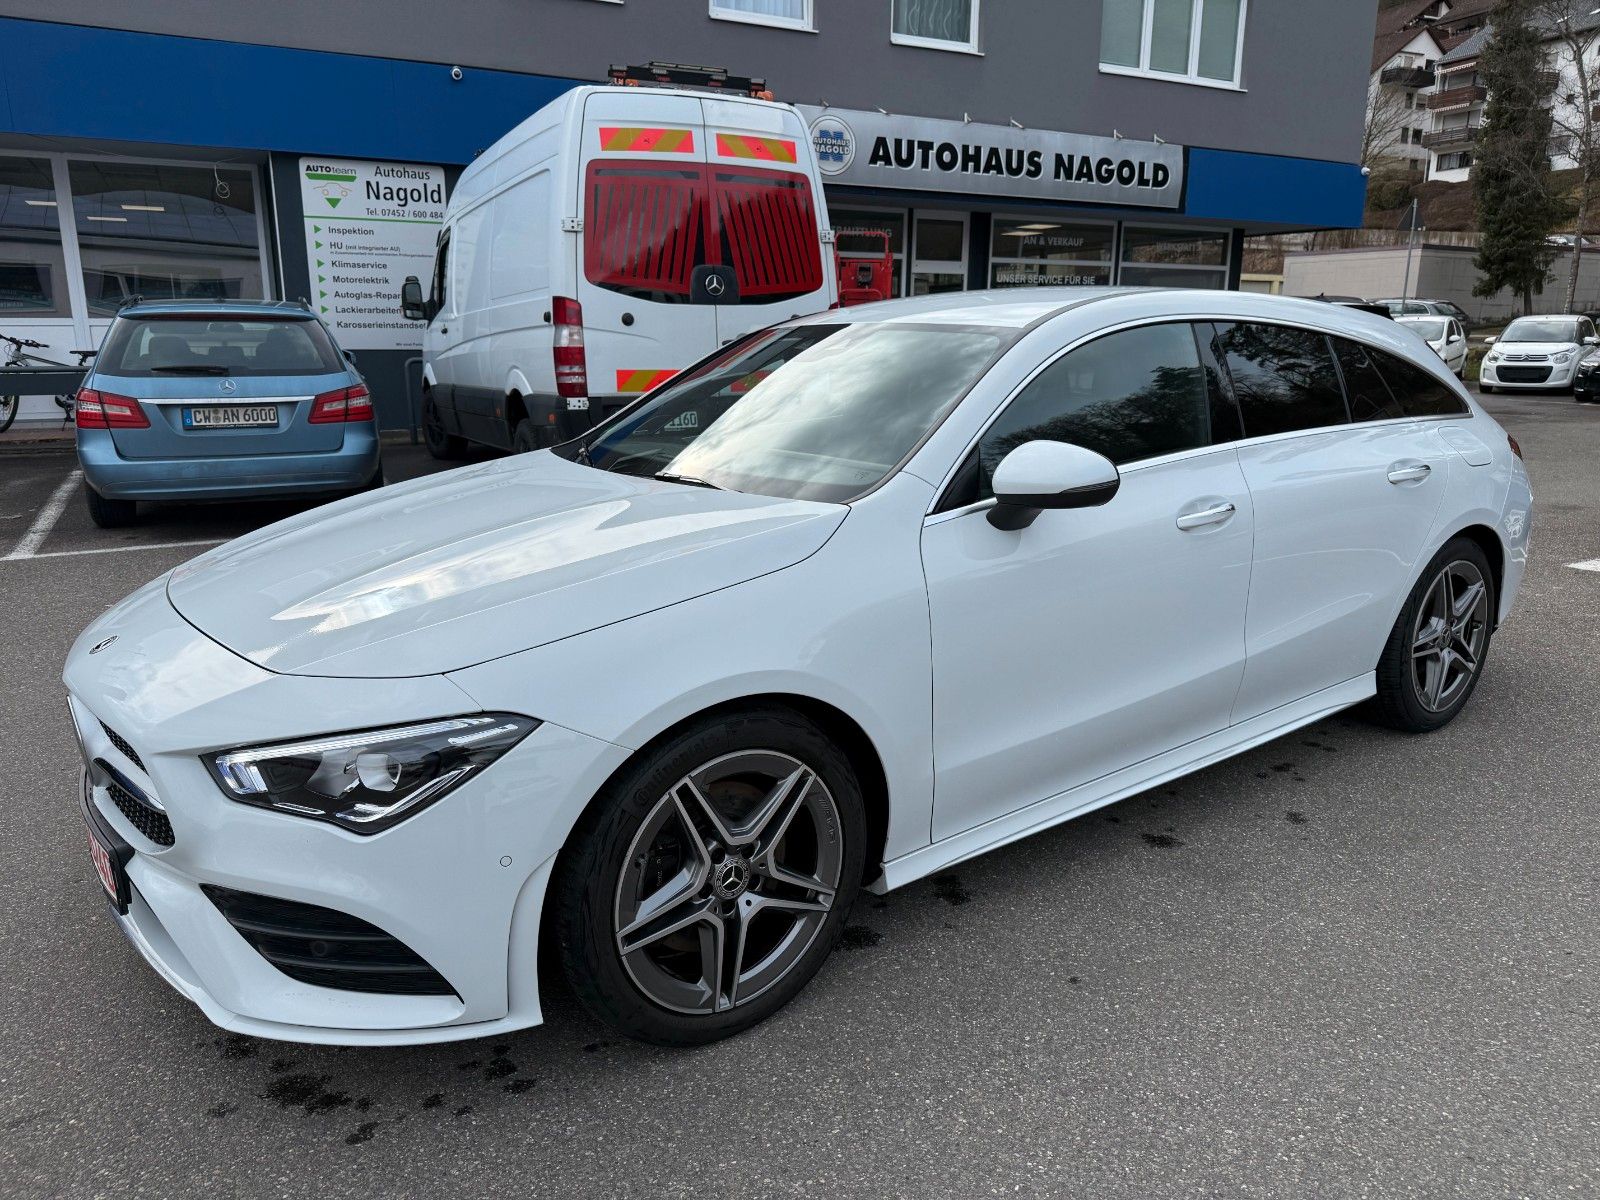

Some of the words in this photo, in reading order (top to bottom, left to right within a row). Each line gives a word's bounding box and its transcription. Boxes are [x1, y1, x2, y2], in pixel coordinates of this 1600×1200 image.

[813, 137, 850, 146] AUTOHAUS
[815, 145, 850, 154] NAGOLD
[868, 136, 1043, 179] AUTOHAUS
[1054, 152, 1170, 189] NAGOLD
[305, 164, 357, 175] AUTOteam
[374, 166, 430, 180] Autohaus
[366, 180, 443, 207] Nagold
[366, 208, 379, 216] Tel.
[381, 209, 406, 217] 07452
[413, 210, 427, 218] 600
[429, 211, 444, 219] 484
[328, 226, 374, 236] Inspektion
[330, 241, 343, 250] HU
[1023, 237, 1037, 245] AN
[1038, 237, 1045, 246] &
[1047, 237, 1085, 247] VERKAUF
[331, 260, 388, 269] Klimaservice
[332, 275, 390, 284] Motorelektrik
[996, 274, 1026, 283] UNSER
[1027, 274, 1062, 285] SERVICE
[1064, 273, 1080, 285] FÜR
[1082, 276, 1095, 285] SIE
[335, 306, 401, 315] Lackierarbeiten
[193, 410, 211, 423] CW
[223, 409, 240, 422] AN
[243, 408, 276, 422] 6000
